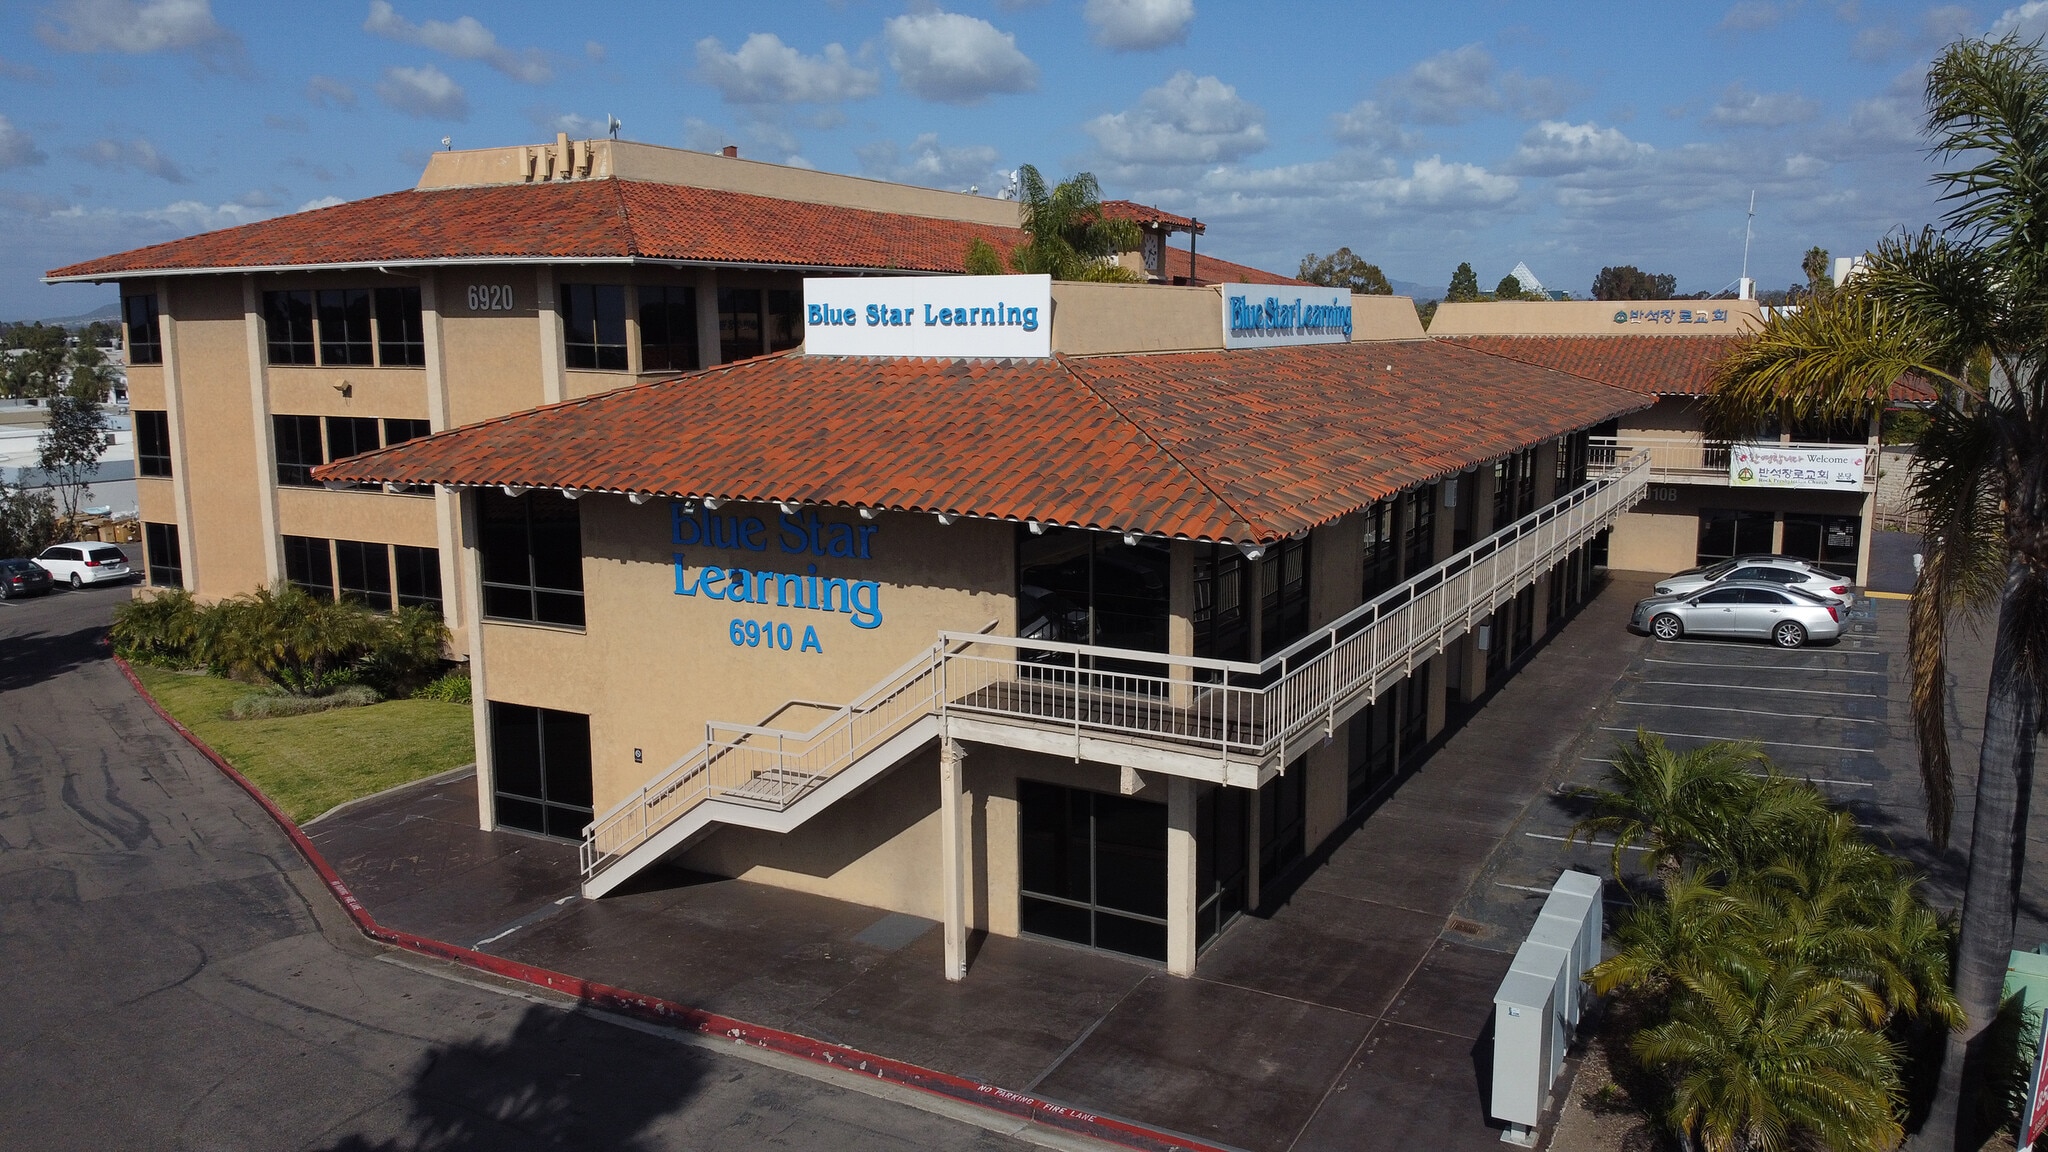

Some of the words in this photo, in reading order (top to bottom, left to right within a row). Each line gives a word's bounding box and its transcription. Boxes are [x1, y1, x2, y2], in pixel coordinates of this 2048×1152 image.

[468, 284, 513, 310] 6920
[807, 303, 857, 326] Blue
[866, 303, 915, 326] Star
[923, 302, 1039, 331] Learning
[1230, 295, 1264, 330] Blue
[1265, 297, 1296, 330] Star
[1295, 297, 1352, 335] Learning
[1758, 467, 1829, 480] 반석장로교회
[1806, 454, 1848, 464] Welcome
[1646, 486, 1677, 501] 10B
[669, 501, 767, 552] Blue
[778, 507, 879, 560] Star
[672, 553, 883, 629] Learning
[729, 618, 793, 651] 6910
[800, 625, 823, 654] A
[977, 1084, 993, 1093] NO
[994, 1087, 1034, 1105] PARKING
[1042, 1103, 1068, 1115] FIRE
[1069, 1110, 1097, 1122] LANE
